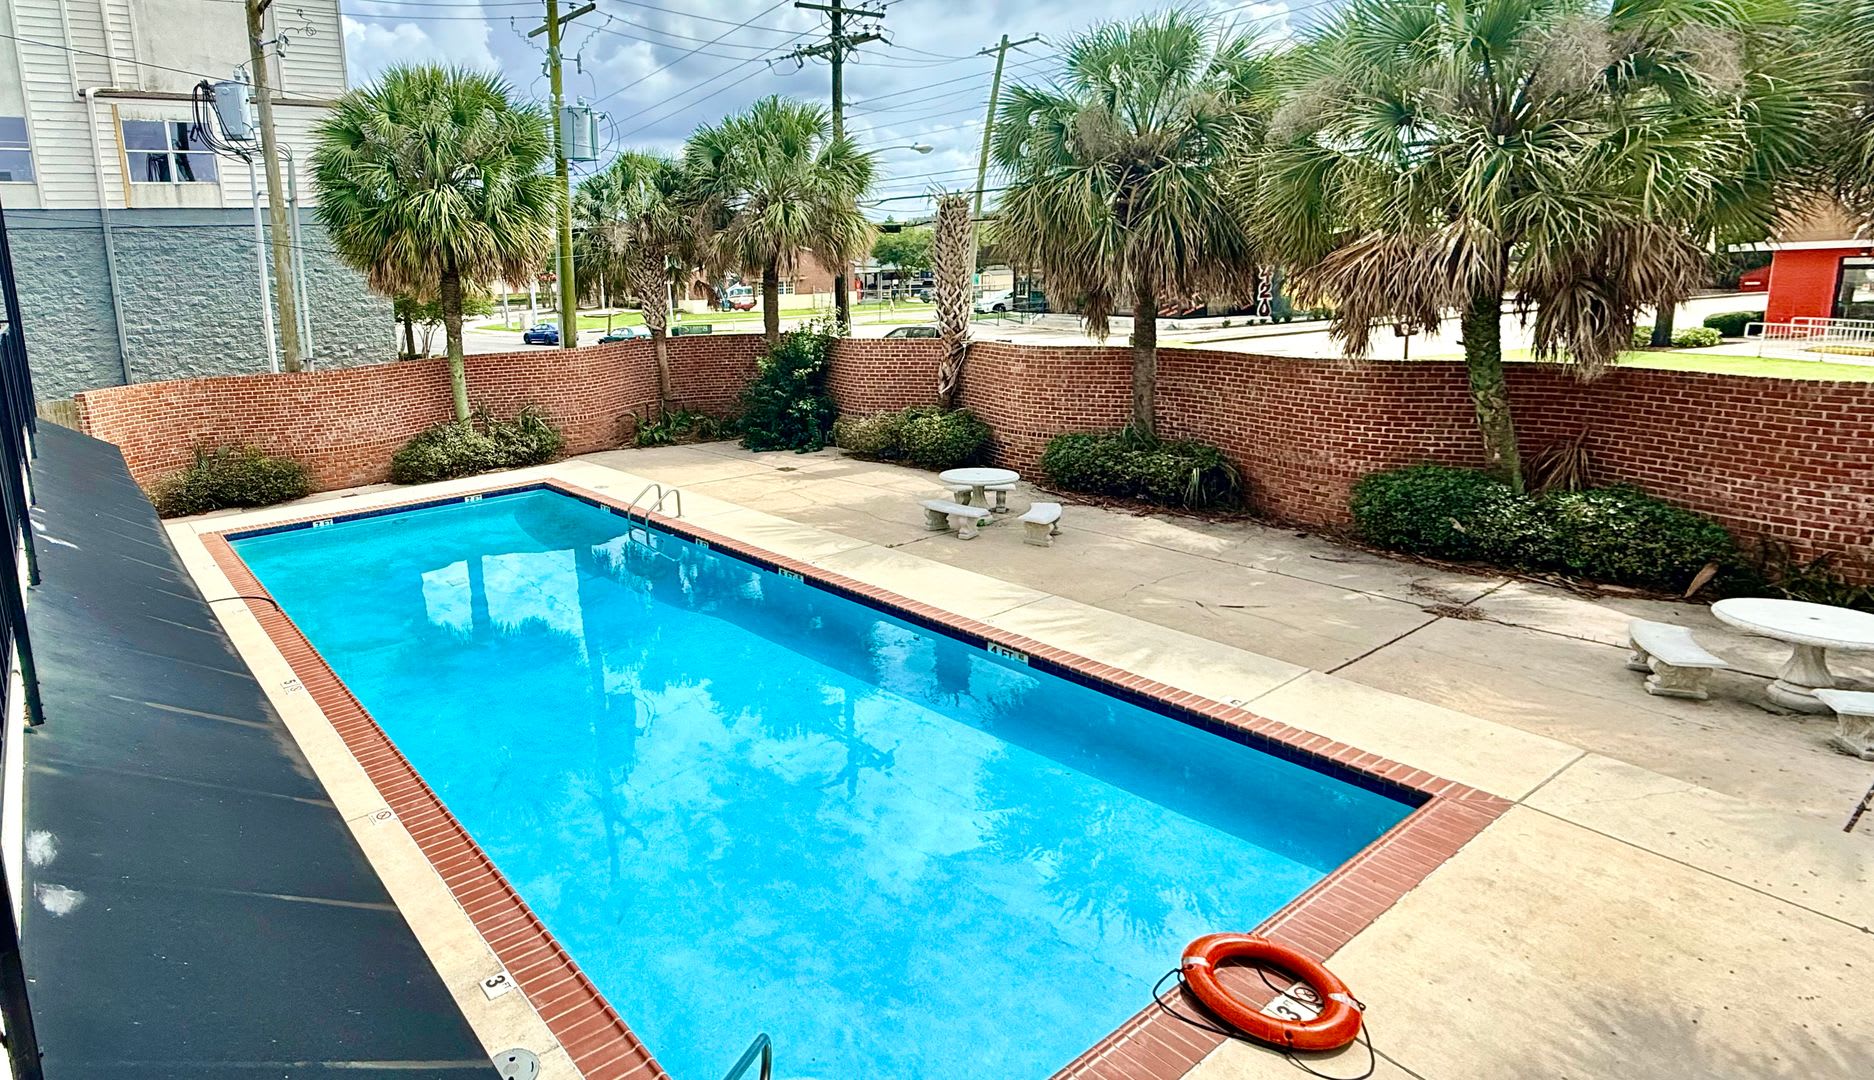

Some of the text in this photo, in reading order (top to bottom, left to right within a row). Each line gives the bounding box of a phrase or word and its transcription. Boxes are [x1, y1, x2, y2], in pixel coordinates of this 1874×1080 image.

[1256, 263, 1275, 318] 420
[991, 645, 998, 654] 4
[1001, 649, 1014, 659] FT
[485, 975, 506, 988] 3
[1277, 1005, 1302, 1021] 3
